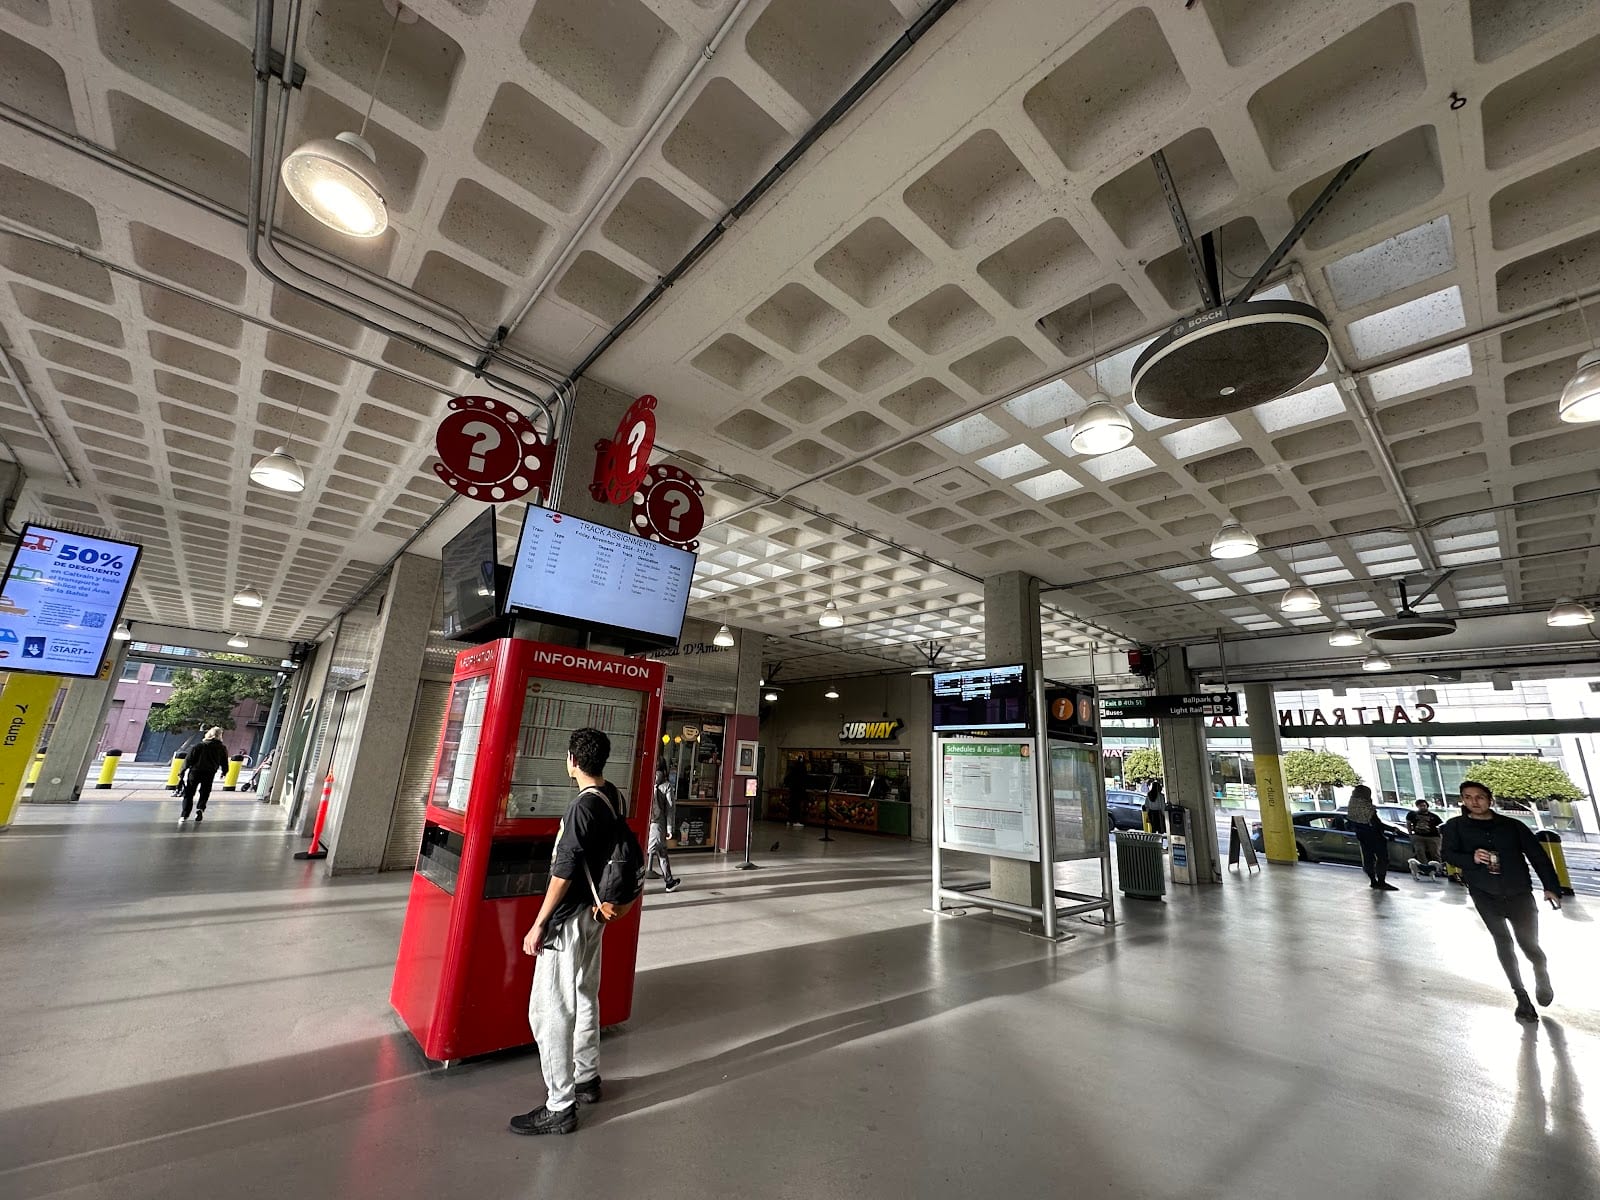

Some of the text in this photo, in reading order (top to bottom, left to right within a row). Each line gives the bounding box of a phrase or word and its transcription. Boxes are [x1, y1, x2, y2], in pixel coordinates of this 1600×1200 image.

[1188, 310, 1223, 329] BOSCH
[553, 531, 564, 539] Type
[579, 522, 657, 550] TRACK ASSIGNMENTS
[57, 544, 123, 569] 50%
[63, 570, 94, 580] Caltrain
[68, 564, 121, 577] DESCUENTO
[53, 645, 82, 655] START
[533, 650, 649, 679] INFORMATION
[1182, 696, 1212, 704] Ballpark
[1170, 707, 1188, 715] Light
[3, 717, 27, 746] ramp
[839, 721, 895, 739] SUBWAY
[946, 744, 976, 753] Schedules
[983, 745, 1001, 754] Fares
